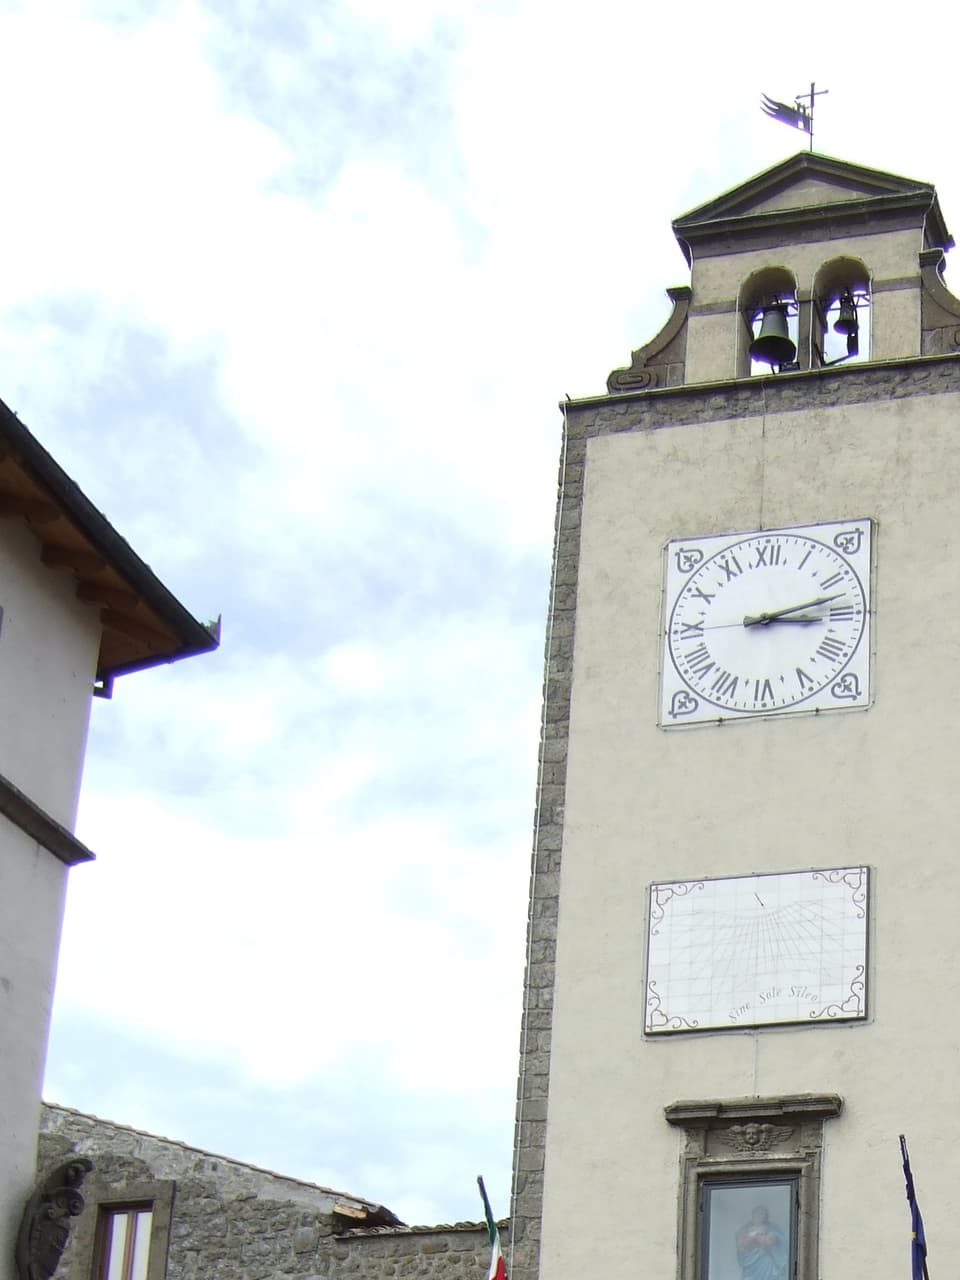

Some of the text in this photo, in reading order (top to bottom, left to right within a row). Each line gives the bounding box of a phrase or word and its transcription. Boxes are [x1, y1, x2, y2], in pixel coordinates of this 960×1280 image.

[755, 545, 781, 568] XII
[718, 555, 743, 582] XI
[820, 572, 844, 590] II
[691, 587, 715, 605] X
[829, 605, 854, 621] III
[680, 620, 704, 640] IX
[816, 636, 846, 662] IIII
[684, 646, 716, 680] VIII
[711, 671, 739, 699] VII
[796, 667, 814, 689] V
[754, 679, 774, 701] VI
[728, 1002, 751, 1024] Sine
[759, 986, 781, 1005] Sole
